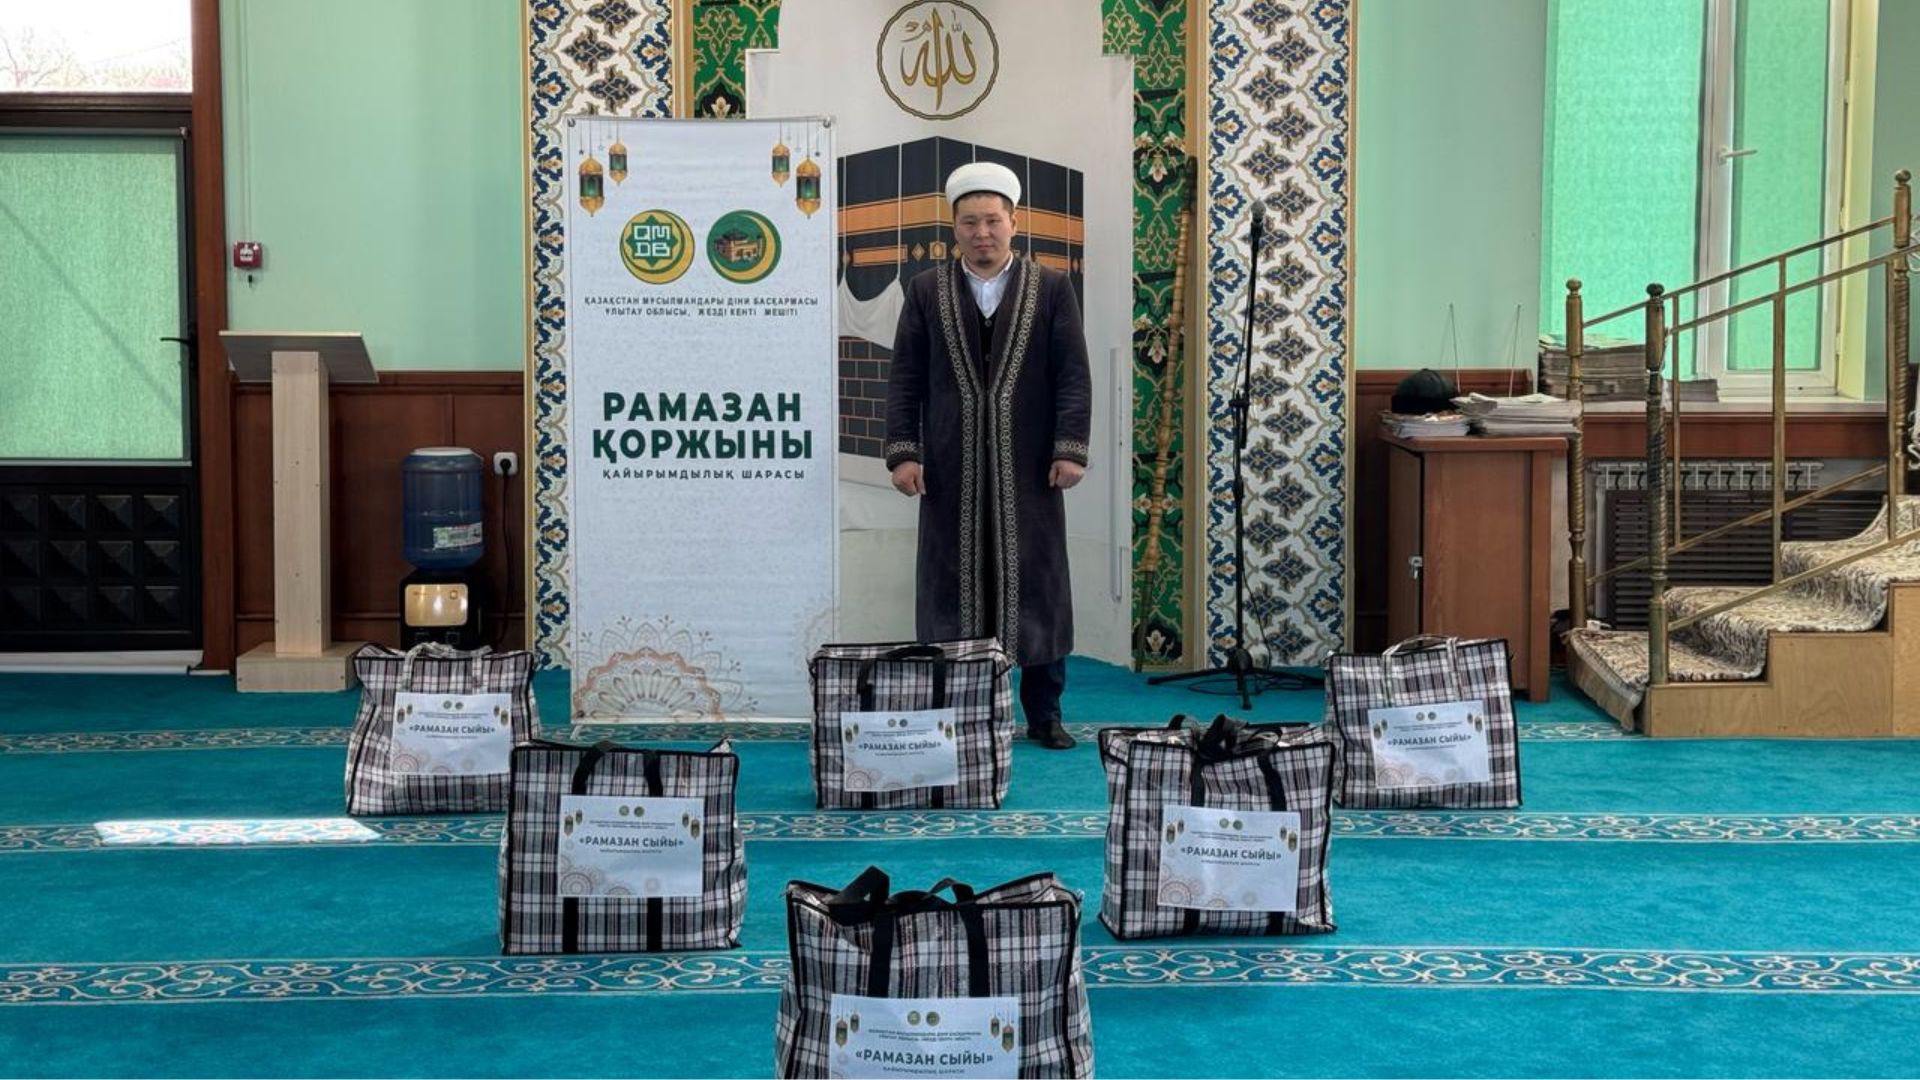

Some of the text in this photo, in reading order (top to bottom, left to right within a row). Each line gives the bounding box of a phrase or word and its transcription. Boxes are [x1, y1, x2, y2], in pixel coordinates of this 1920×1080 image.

[603, 392, 801, 422] РАМАЗАН
[593, 429, 812, 463] ҚОРЖЫНЫ
[602, 468, 805, 480] ҚАЙЫРЫМДЫЛЫҚ ШАРАСЫ
[855, 1049, 994, 1066] «РАМАЗАН СЫЙЫ»
